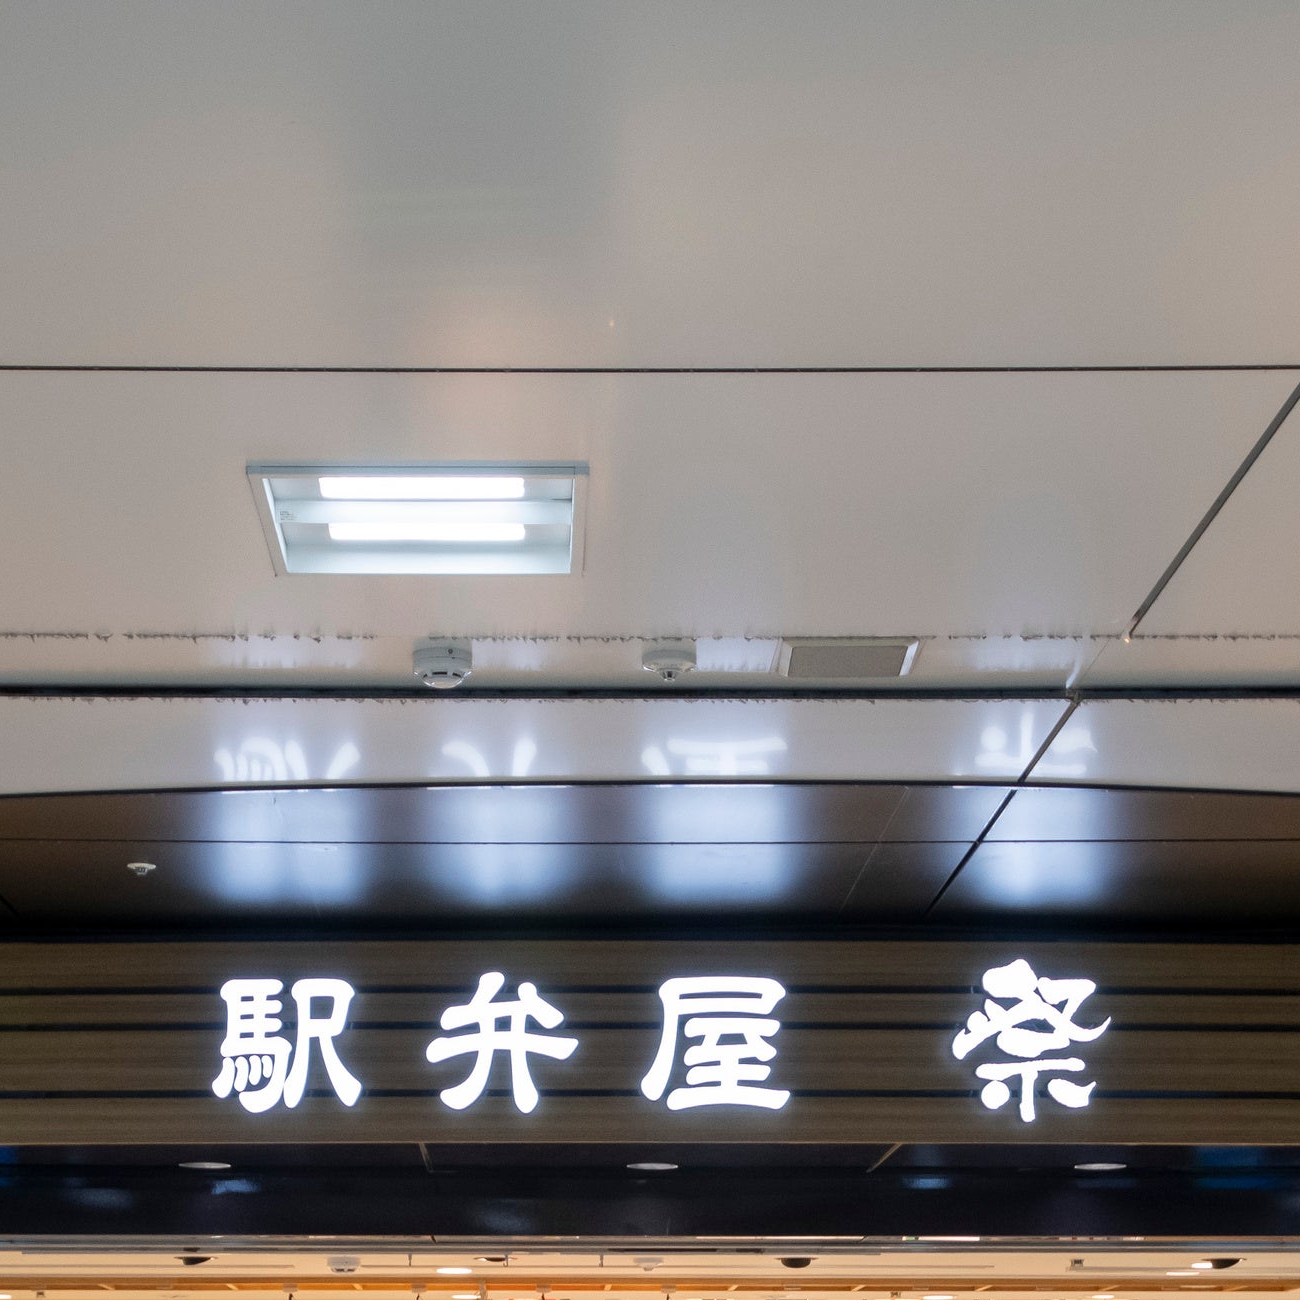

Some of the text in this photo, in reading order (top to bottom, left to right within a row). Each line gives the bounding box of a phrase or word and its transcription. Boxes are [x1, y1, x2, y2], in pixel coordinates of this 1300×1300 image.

[212, 958, 1112, 1122] 駅弁屋 祭
